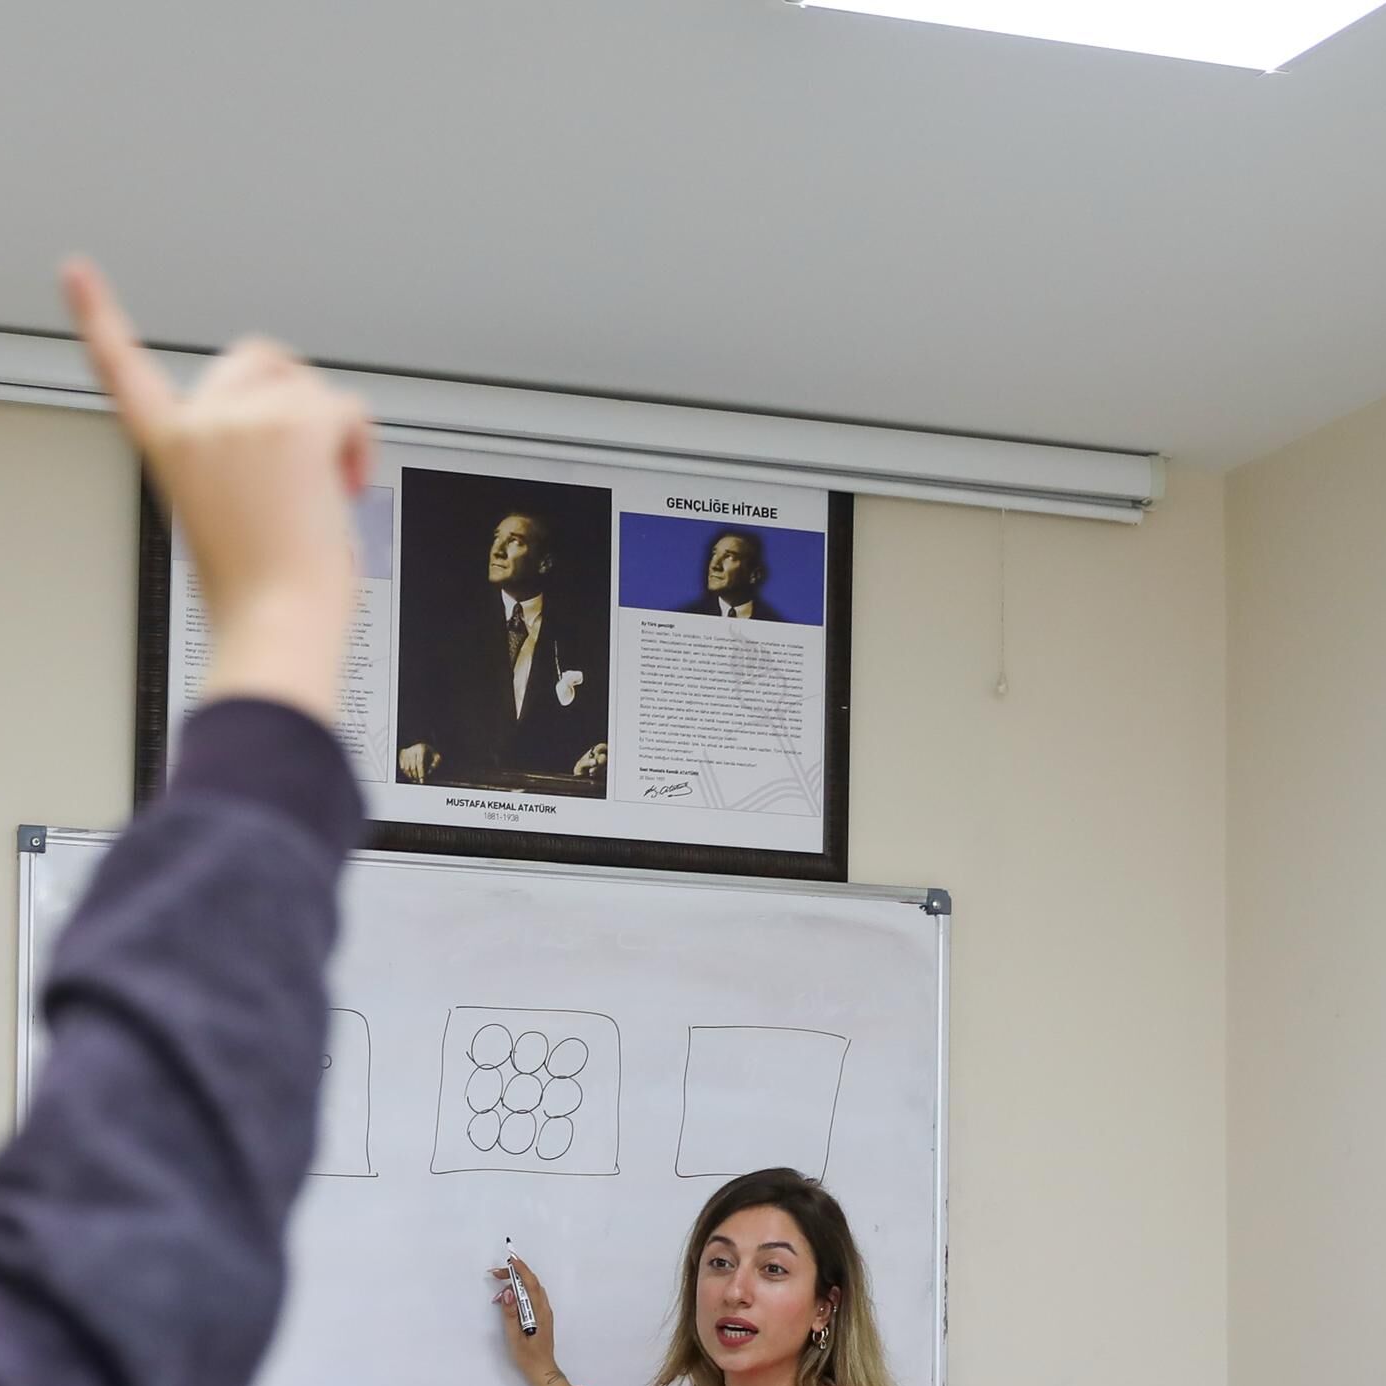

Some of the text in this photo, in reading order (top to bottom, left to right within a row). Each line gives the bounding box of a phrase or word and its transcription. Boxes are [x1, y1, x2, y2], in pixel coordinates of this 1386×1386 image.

[666, 497, 778, 519] GENÇLİĞE HİTABE
[445, 798, 557, 814] MUSTAFA KEMAL ATATÜRK
[484, 812, 519, 822] 1881-1938
